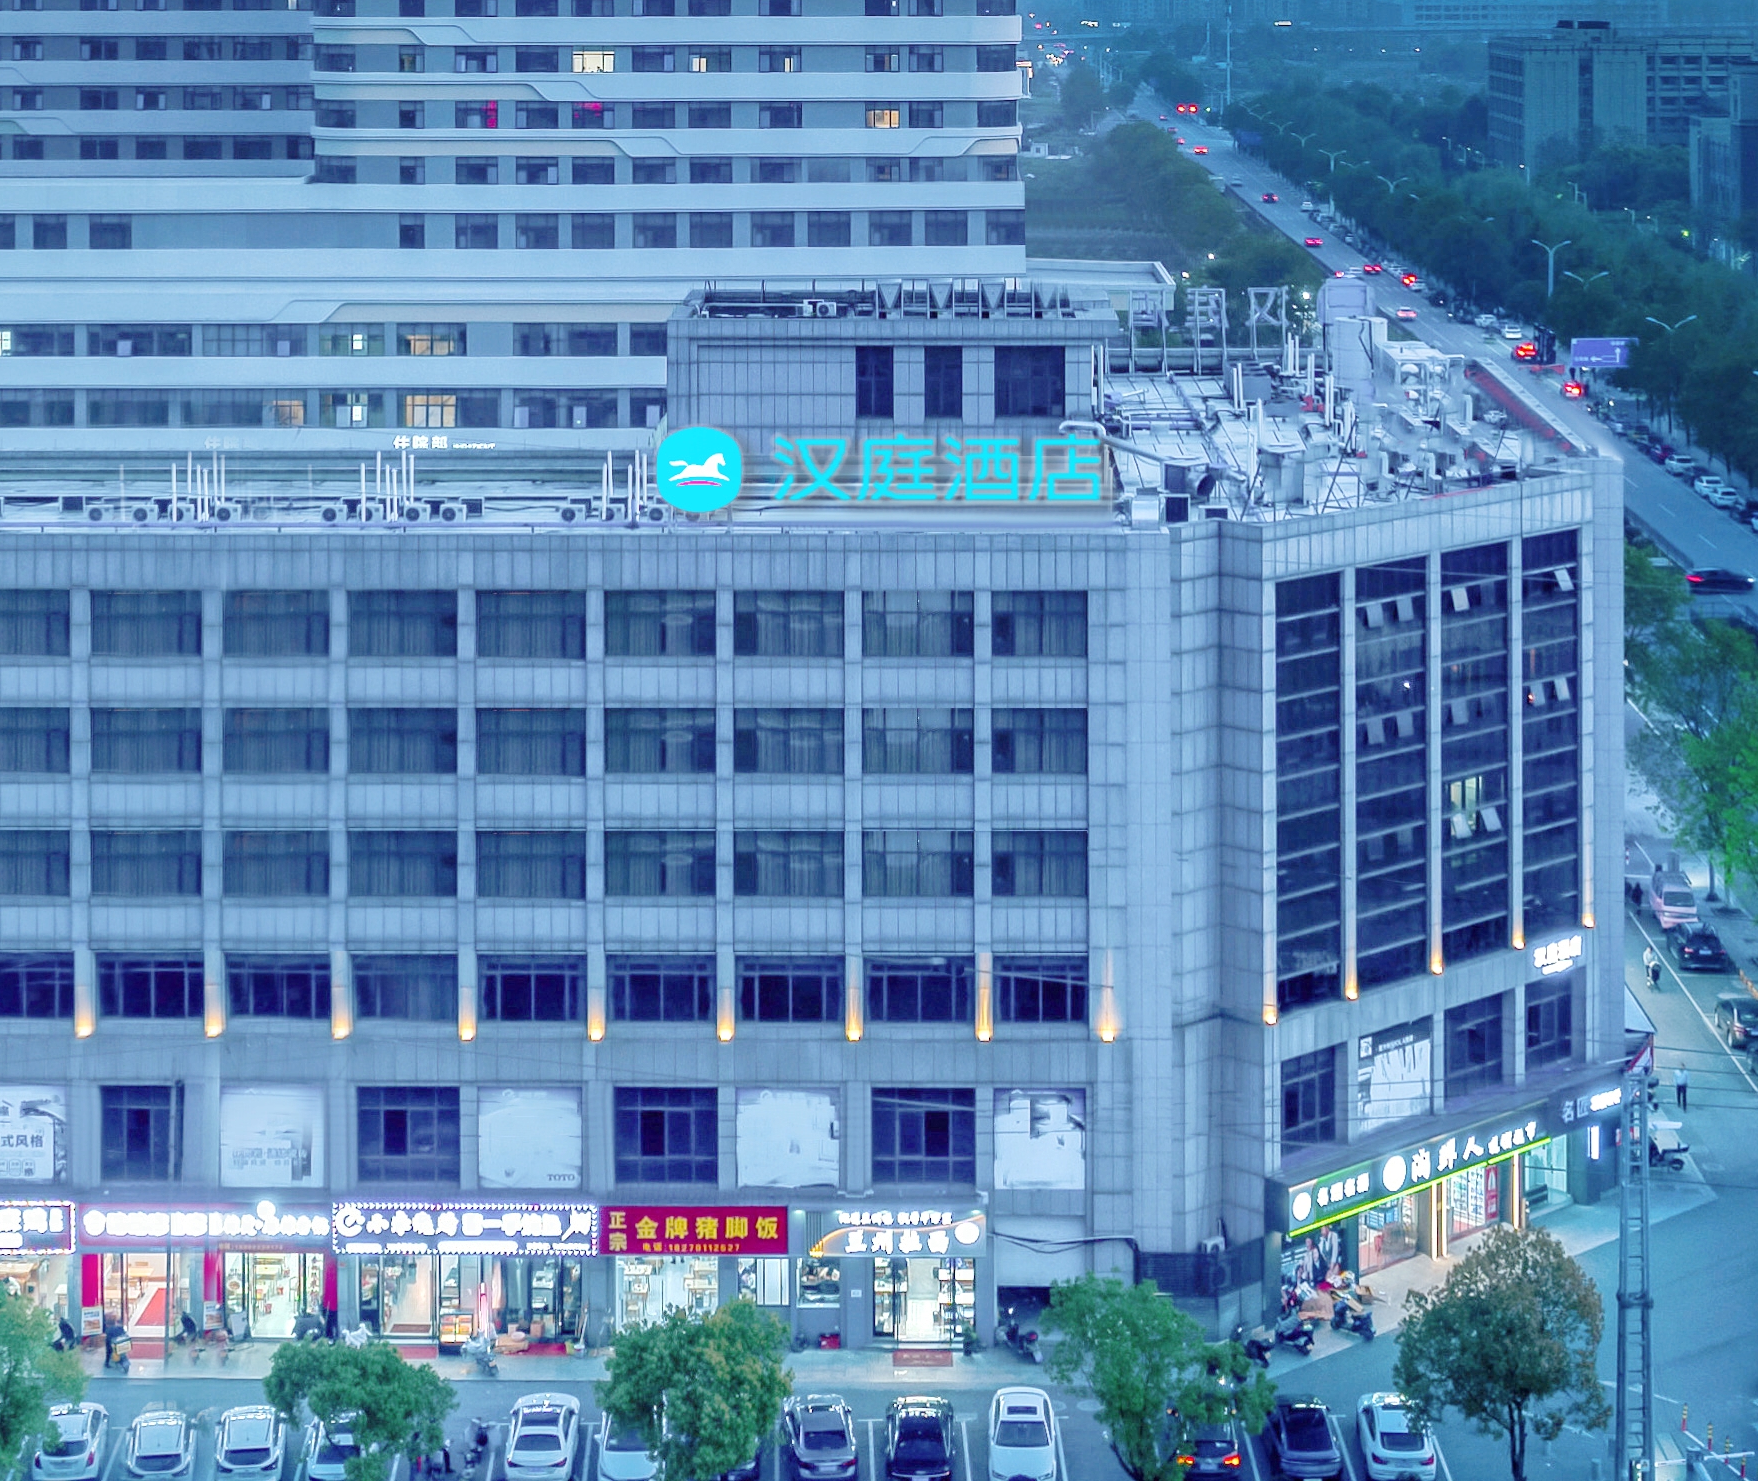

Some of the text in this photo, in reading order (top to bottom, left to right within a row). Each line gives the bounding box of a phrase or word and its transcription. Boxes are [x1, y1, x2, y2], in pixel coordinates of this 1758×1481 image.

[772, 433, 1102, 503] 汉庭酒店
[547, 1173, 575, 1181] TOTO
[608, 1210, 627, 1252] 正宗
[634, 1215, 779, 1241] 金牌猪脚饭
